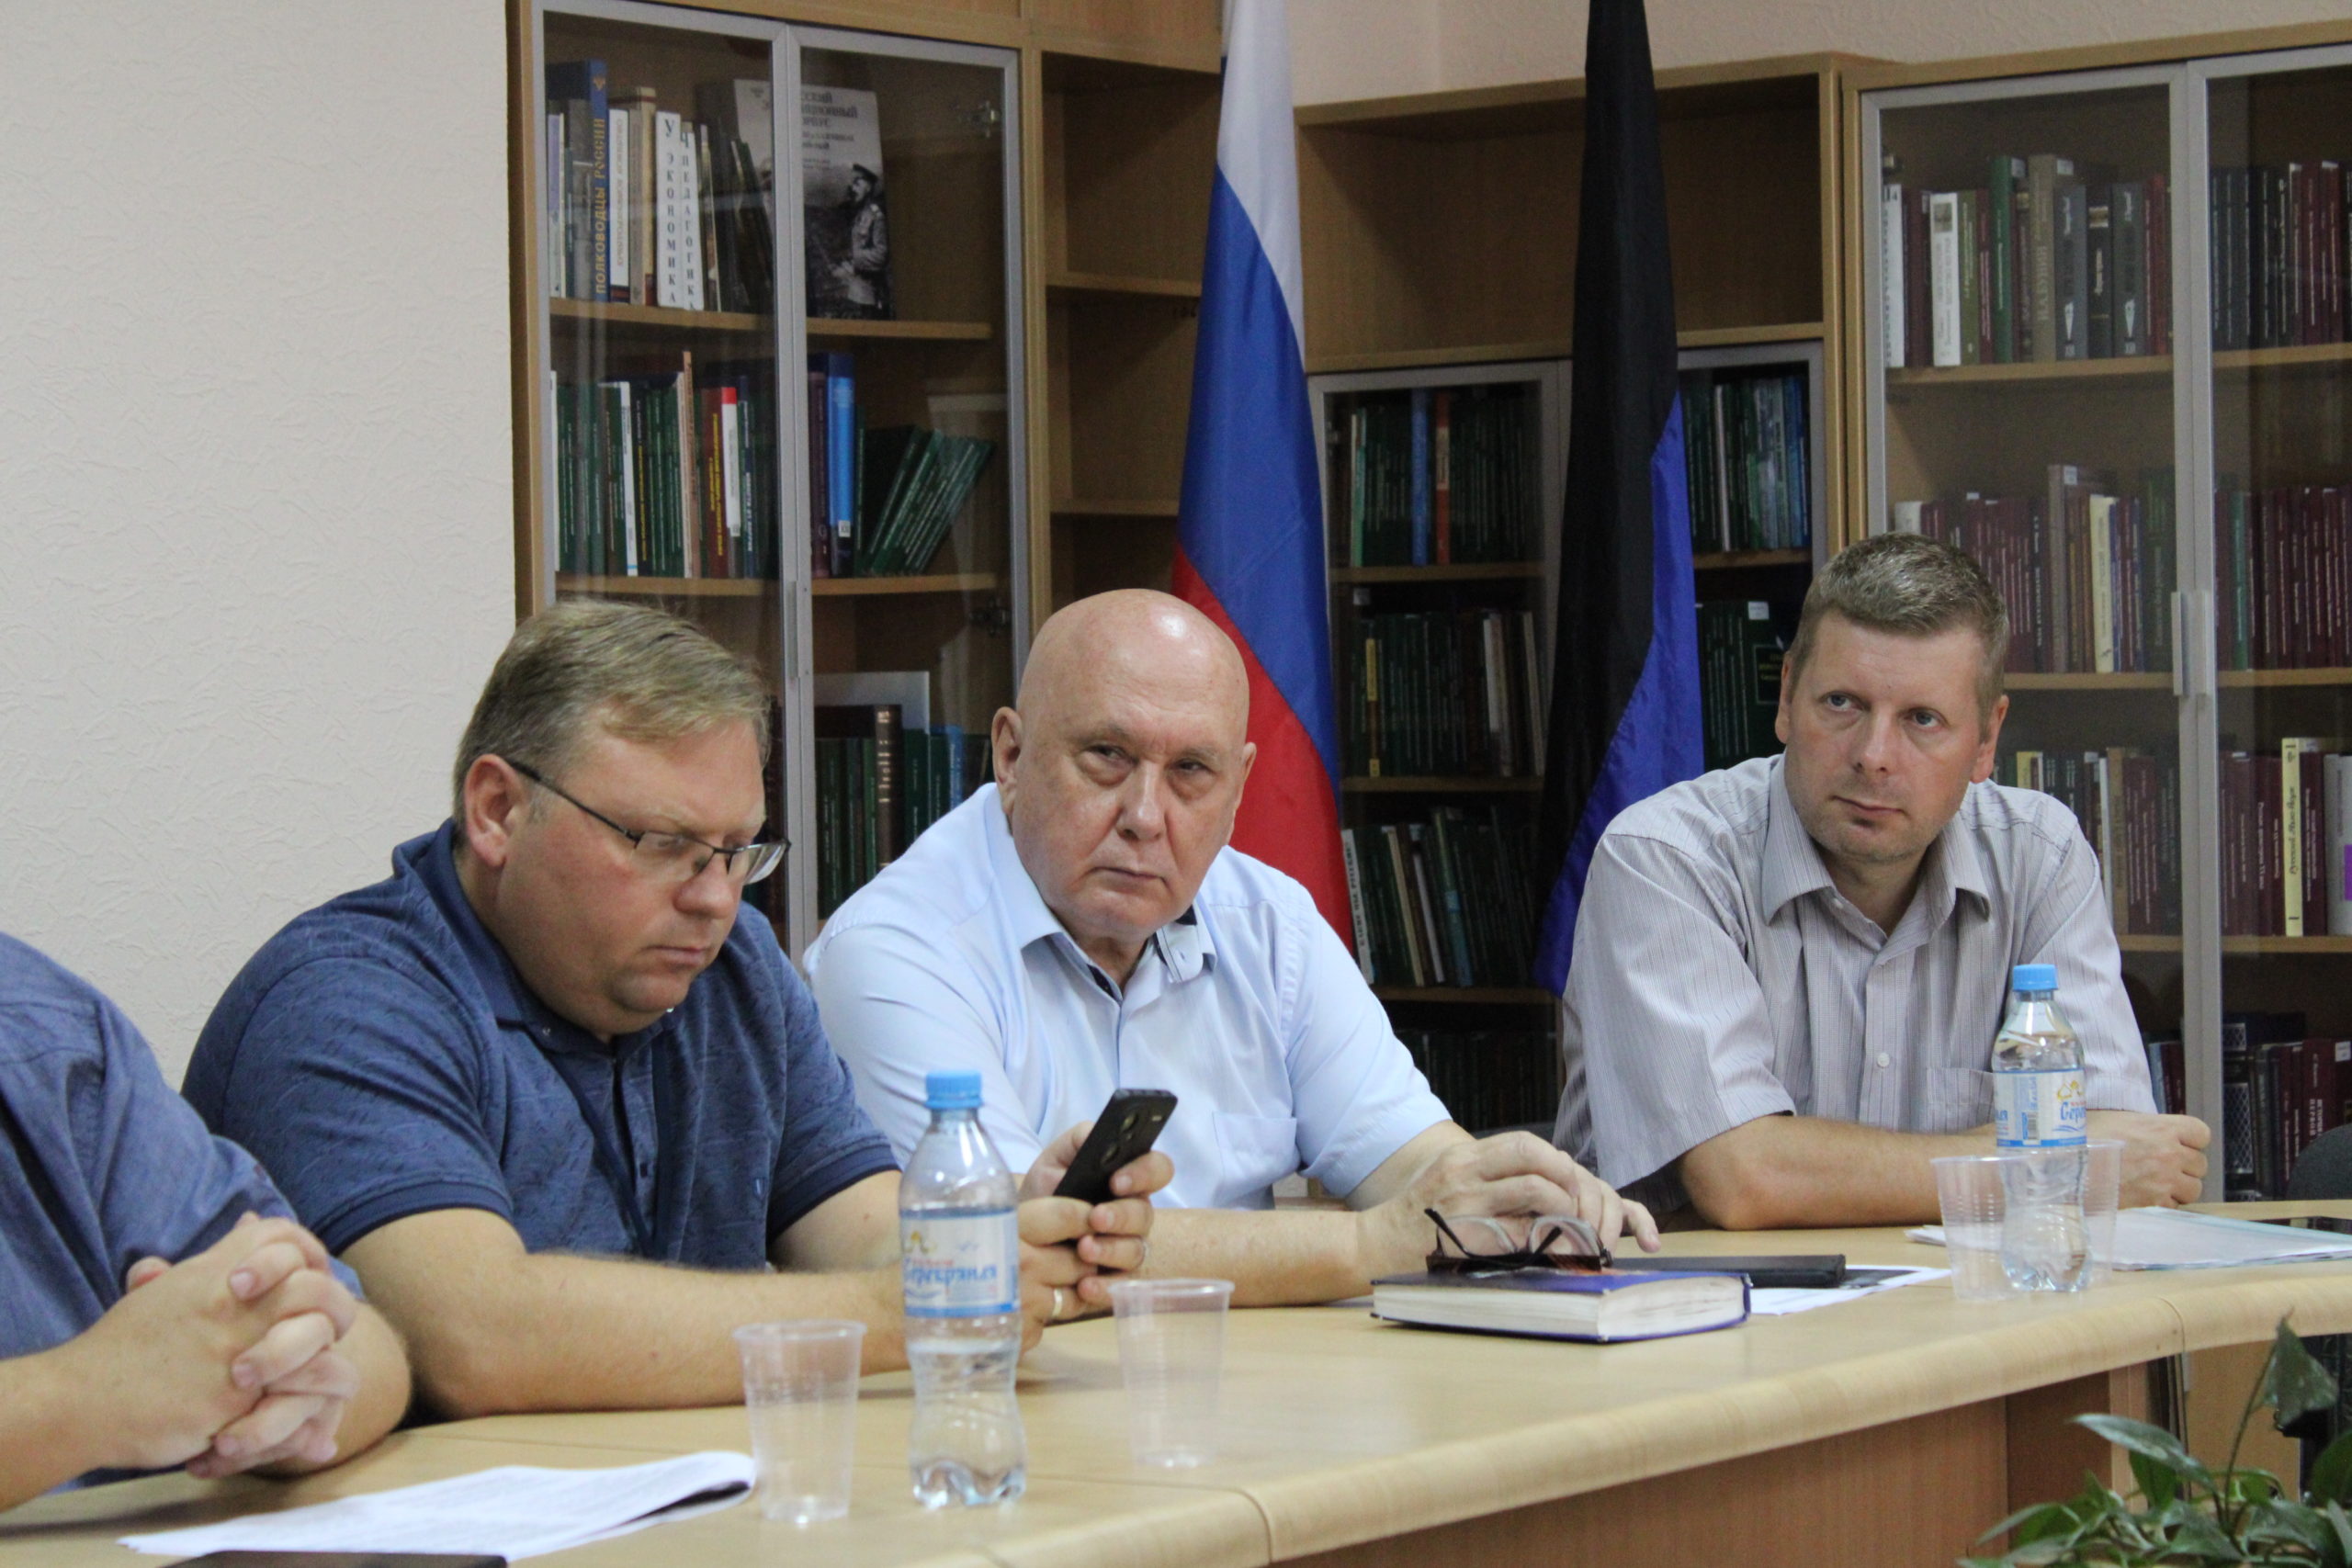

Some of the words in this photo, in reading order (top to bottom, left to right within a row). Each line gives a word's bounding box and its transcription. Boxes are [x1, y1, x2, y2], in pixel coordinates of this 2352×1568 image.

[593, 118, 606, 179] РОССИИ
[594, 186, 606, 294] ПОЛКОВОДЦЫ
[666, 152, 676, 303] ЭКОНОМИКА
